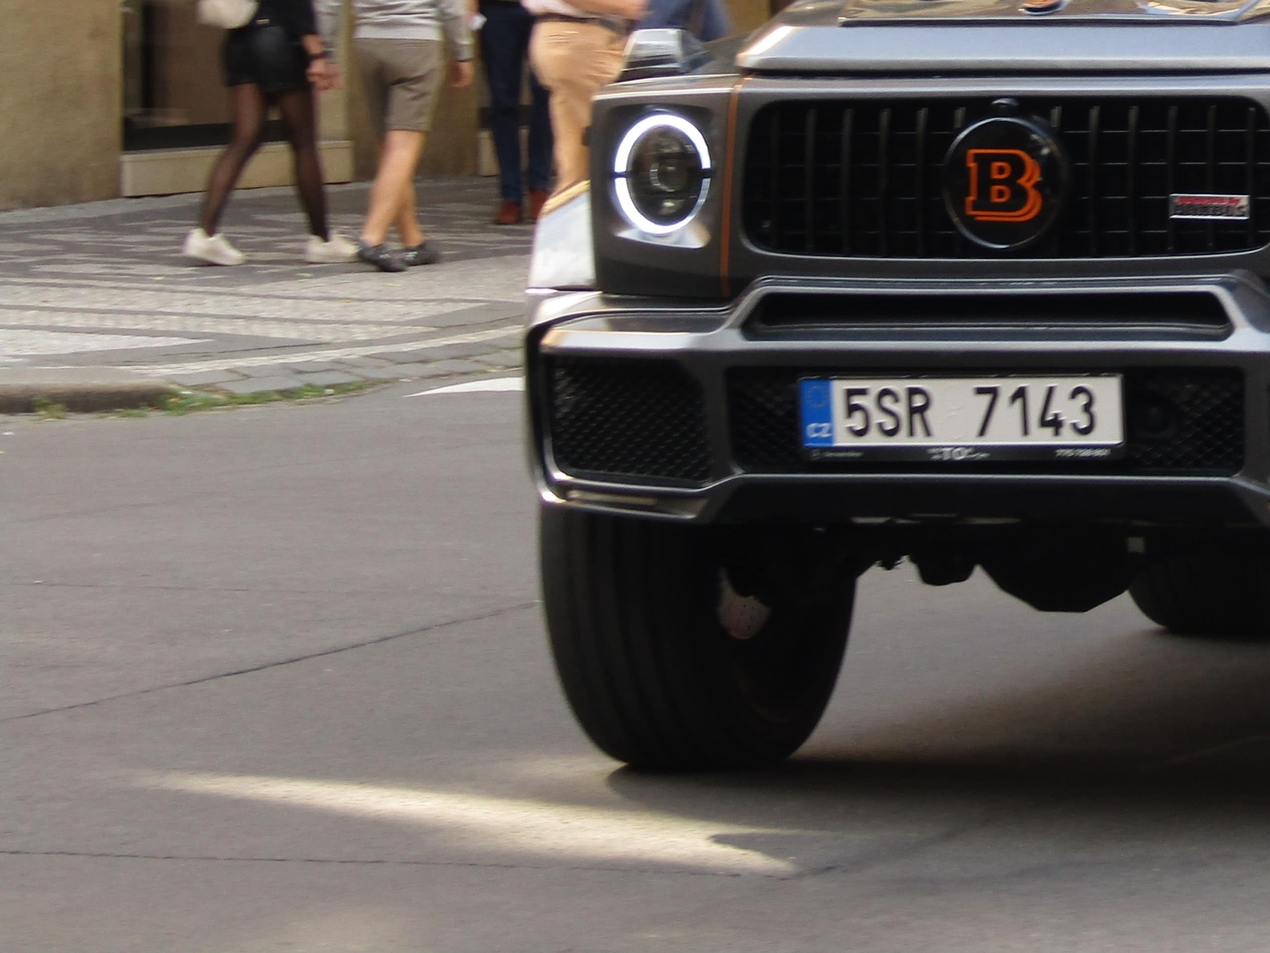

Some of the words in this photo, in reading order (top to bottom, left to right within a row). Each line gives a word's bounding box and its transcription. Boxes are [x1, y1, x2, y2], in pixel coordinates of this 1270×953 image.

[965, 149, 1043, 222] B
[806, 422, 832, 438] CZ
[845, 386, 932, 438] 5SR
[974, 385, 1096, 437] 7143
